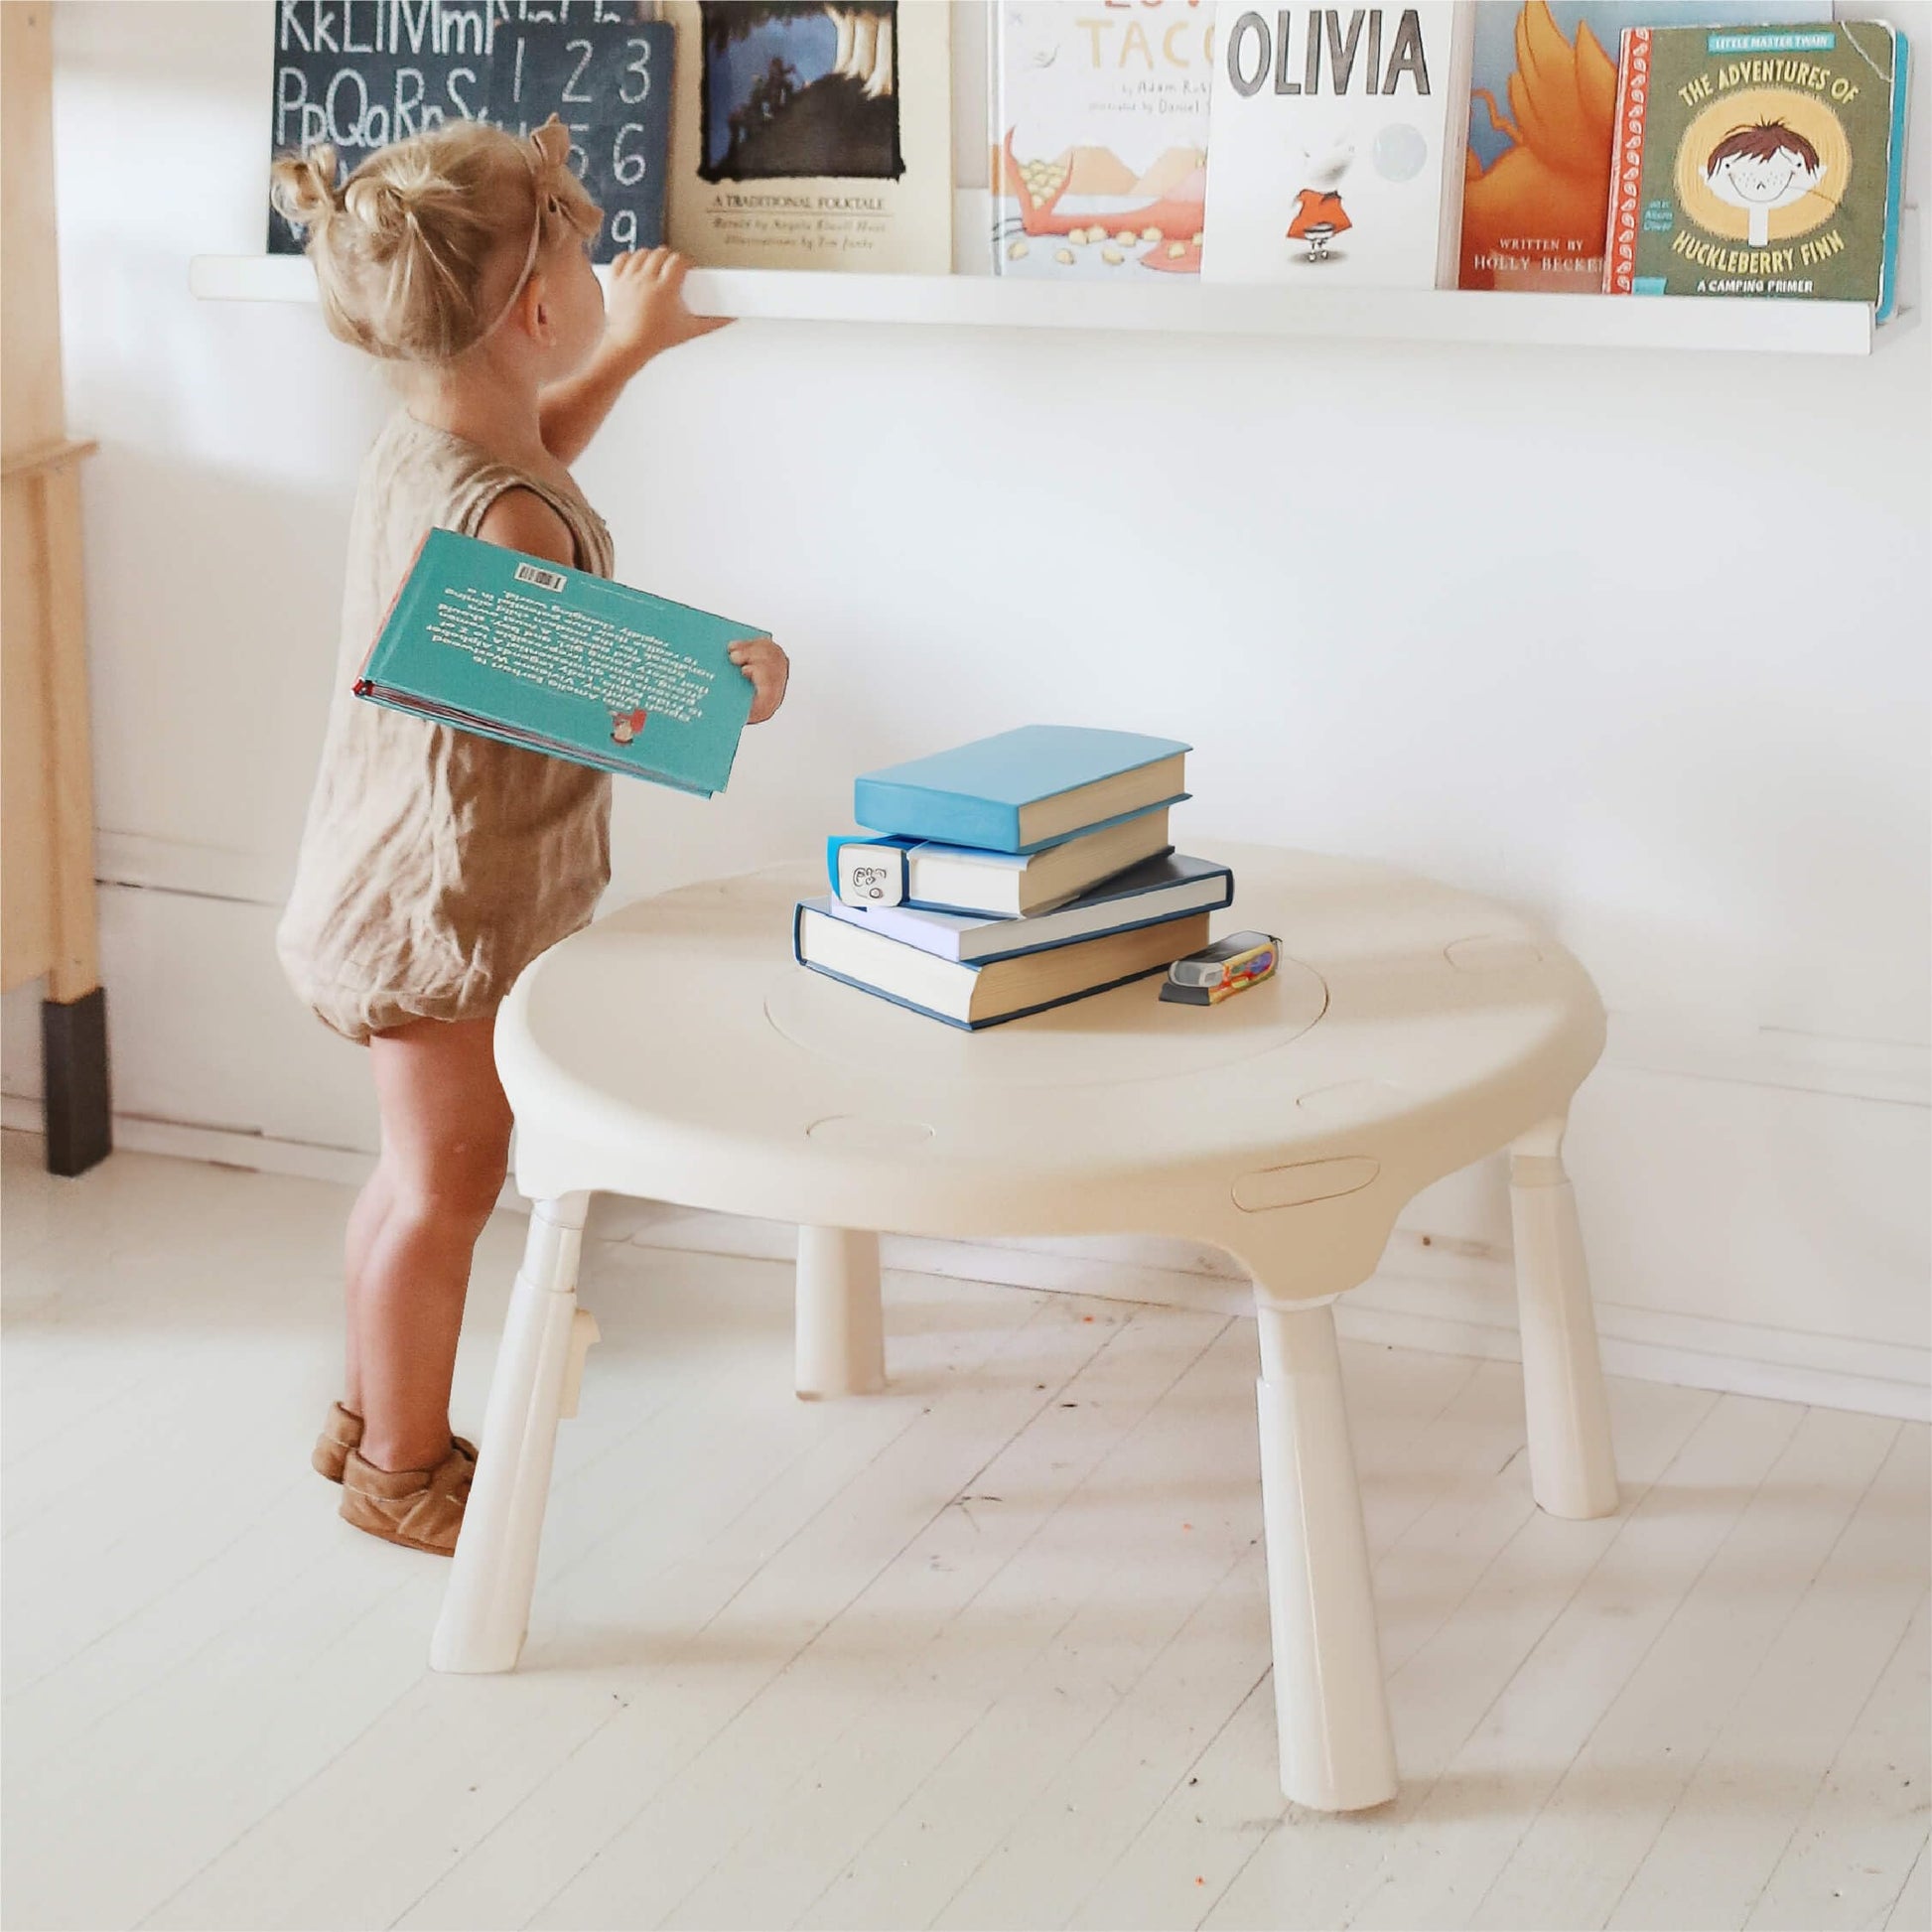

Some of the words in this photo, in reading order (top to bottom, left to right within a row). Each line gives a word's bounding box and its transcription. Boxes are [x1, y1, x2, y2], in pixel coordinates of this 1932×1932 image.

[561, 39, 594, 102] 2
[620, 38, 651, 103] 3
[1226, 9, 1432, 98] OLIVIA
[1678, 74, 1715, 107] THE
[1719, 60, 1831, 90] ADVENTURES
[1831, 77, 1860, 104] OF
[613, 123, 646, 186] 6
[612, 209, 637, 253] 9
[1499, 238, 1561, 252] WRITTEN
[1567, 239, 1584, 252] BY
[1671, 229, 1795, 275] HUCKLEBERRY
[1800, 229, 1846, 266] FINN
[1473, 254, 1531, 271] HOLLY
[1697, 280, 1706, 293] A
[1708, 280, 1765, 293] CAMPING
[1767, 280, 1814, 294] PRIMER
